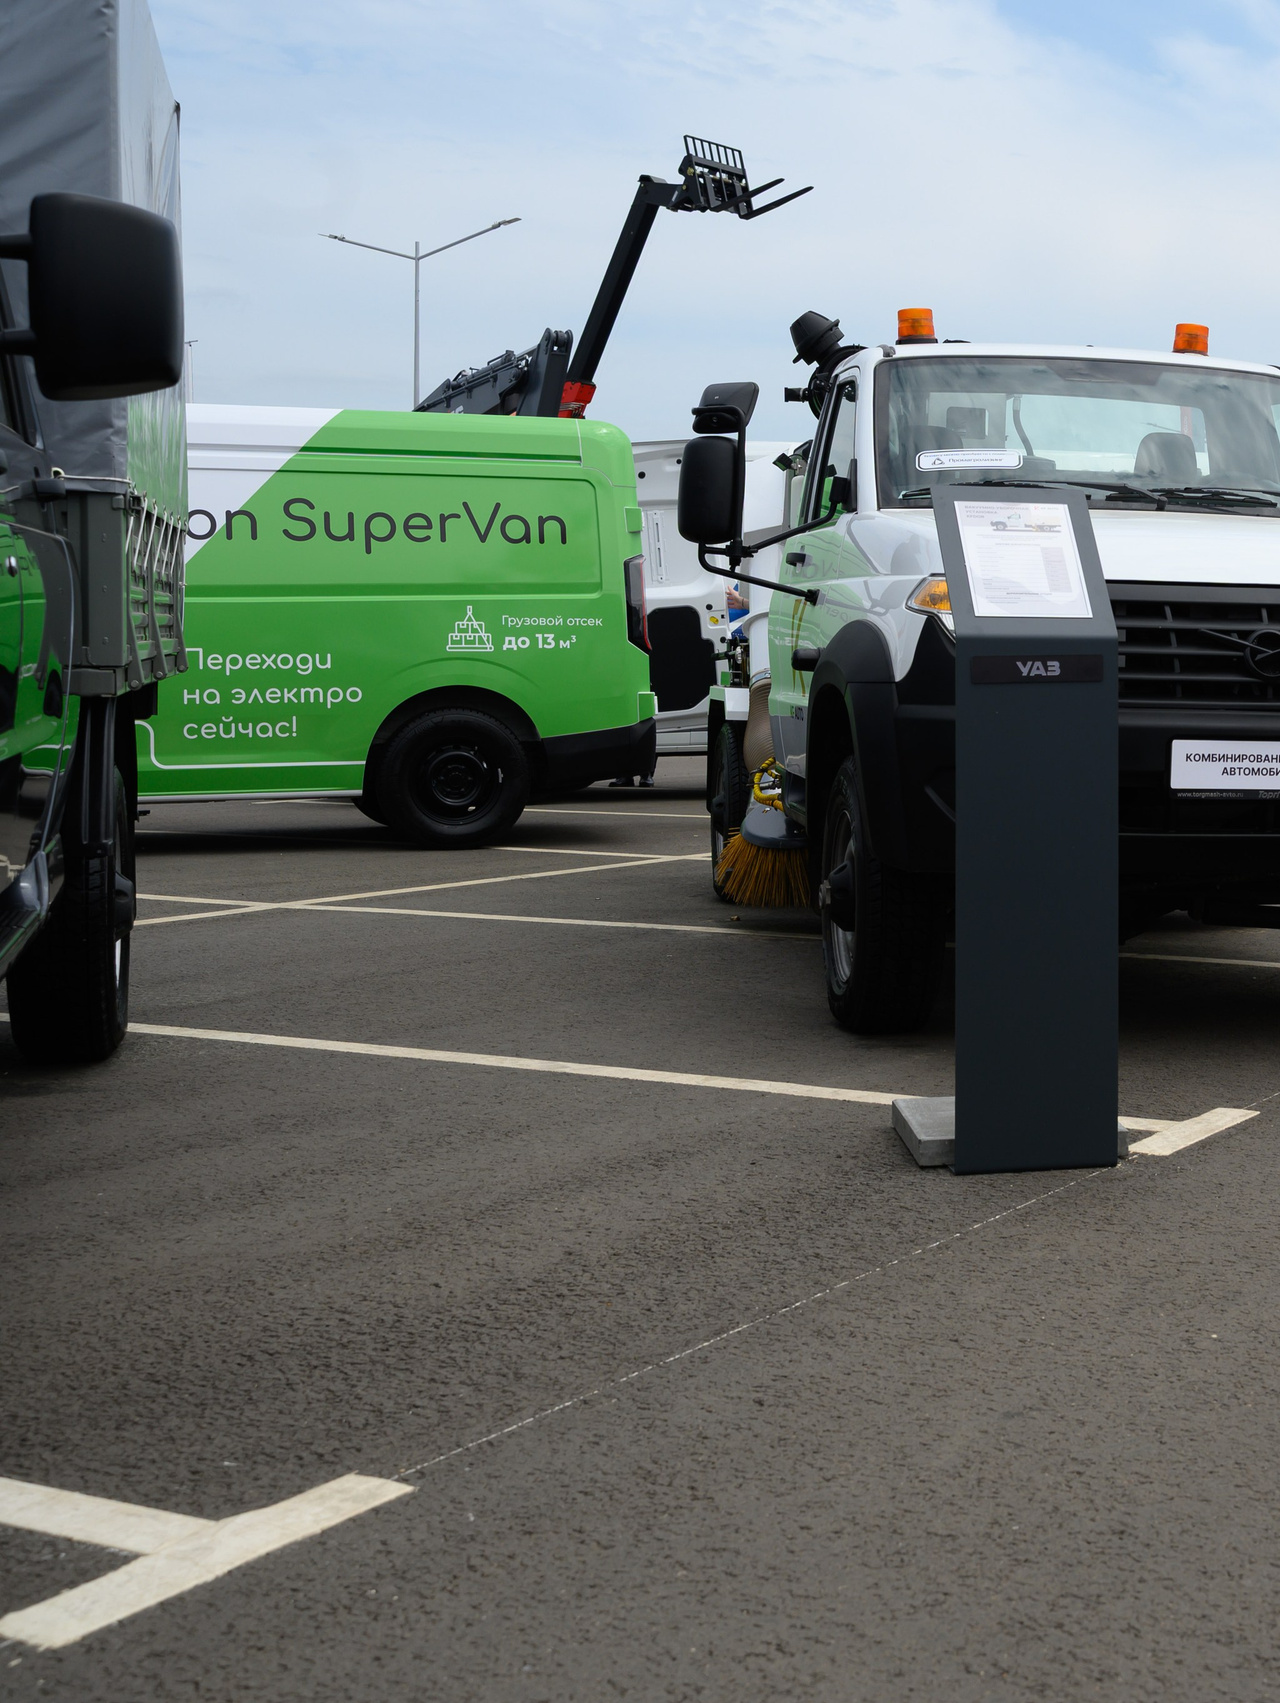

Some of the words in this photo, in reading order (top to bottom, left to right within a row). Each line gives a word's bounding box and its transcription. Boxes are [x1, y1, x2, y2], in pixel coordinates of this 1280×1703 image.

[186, 508, 258, 541] on
[282, 497, 568, 555] SuperVan
[502, 614, 563, 629] Грузовой
[567, 616, 603, 627] отсек
[502, 635, 531, 652] до
[536, 634, 556, 650] 13
[184, 648, 332, 676] Переходи
[1015, 661, 1061, 677] УАЗ
[183, 688, 221, 706] на
[231, 686, 363, 709] электро
[183, 715, 298, 740] сейчас!
